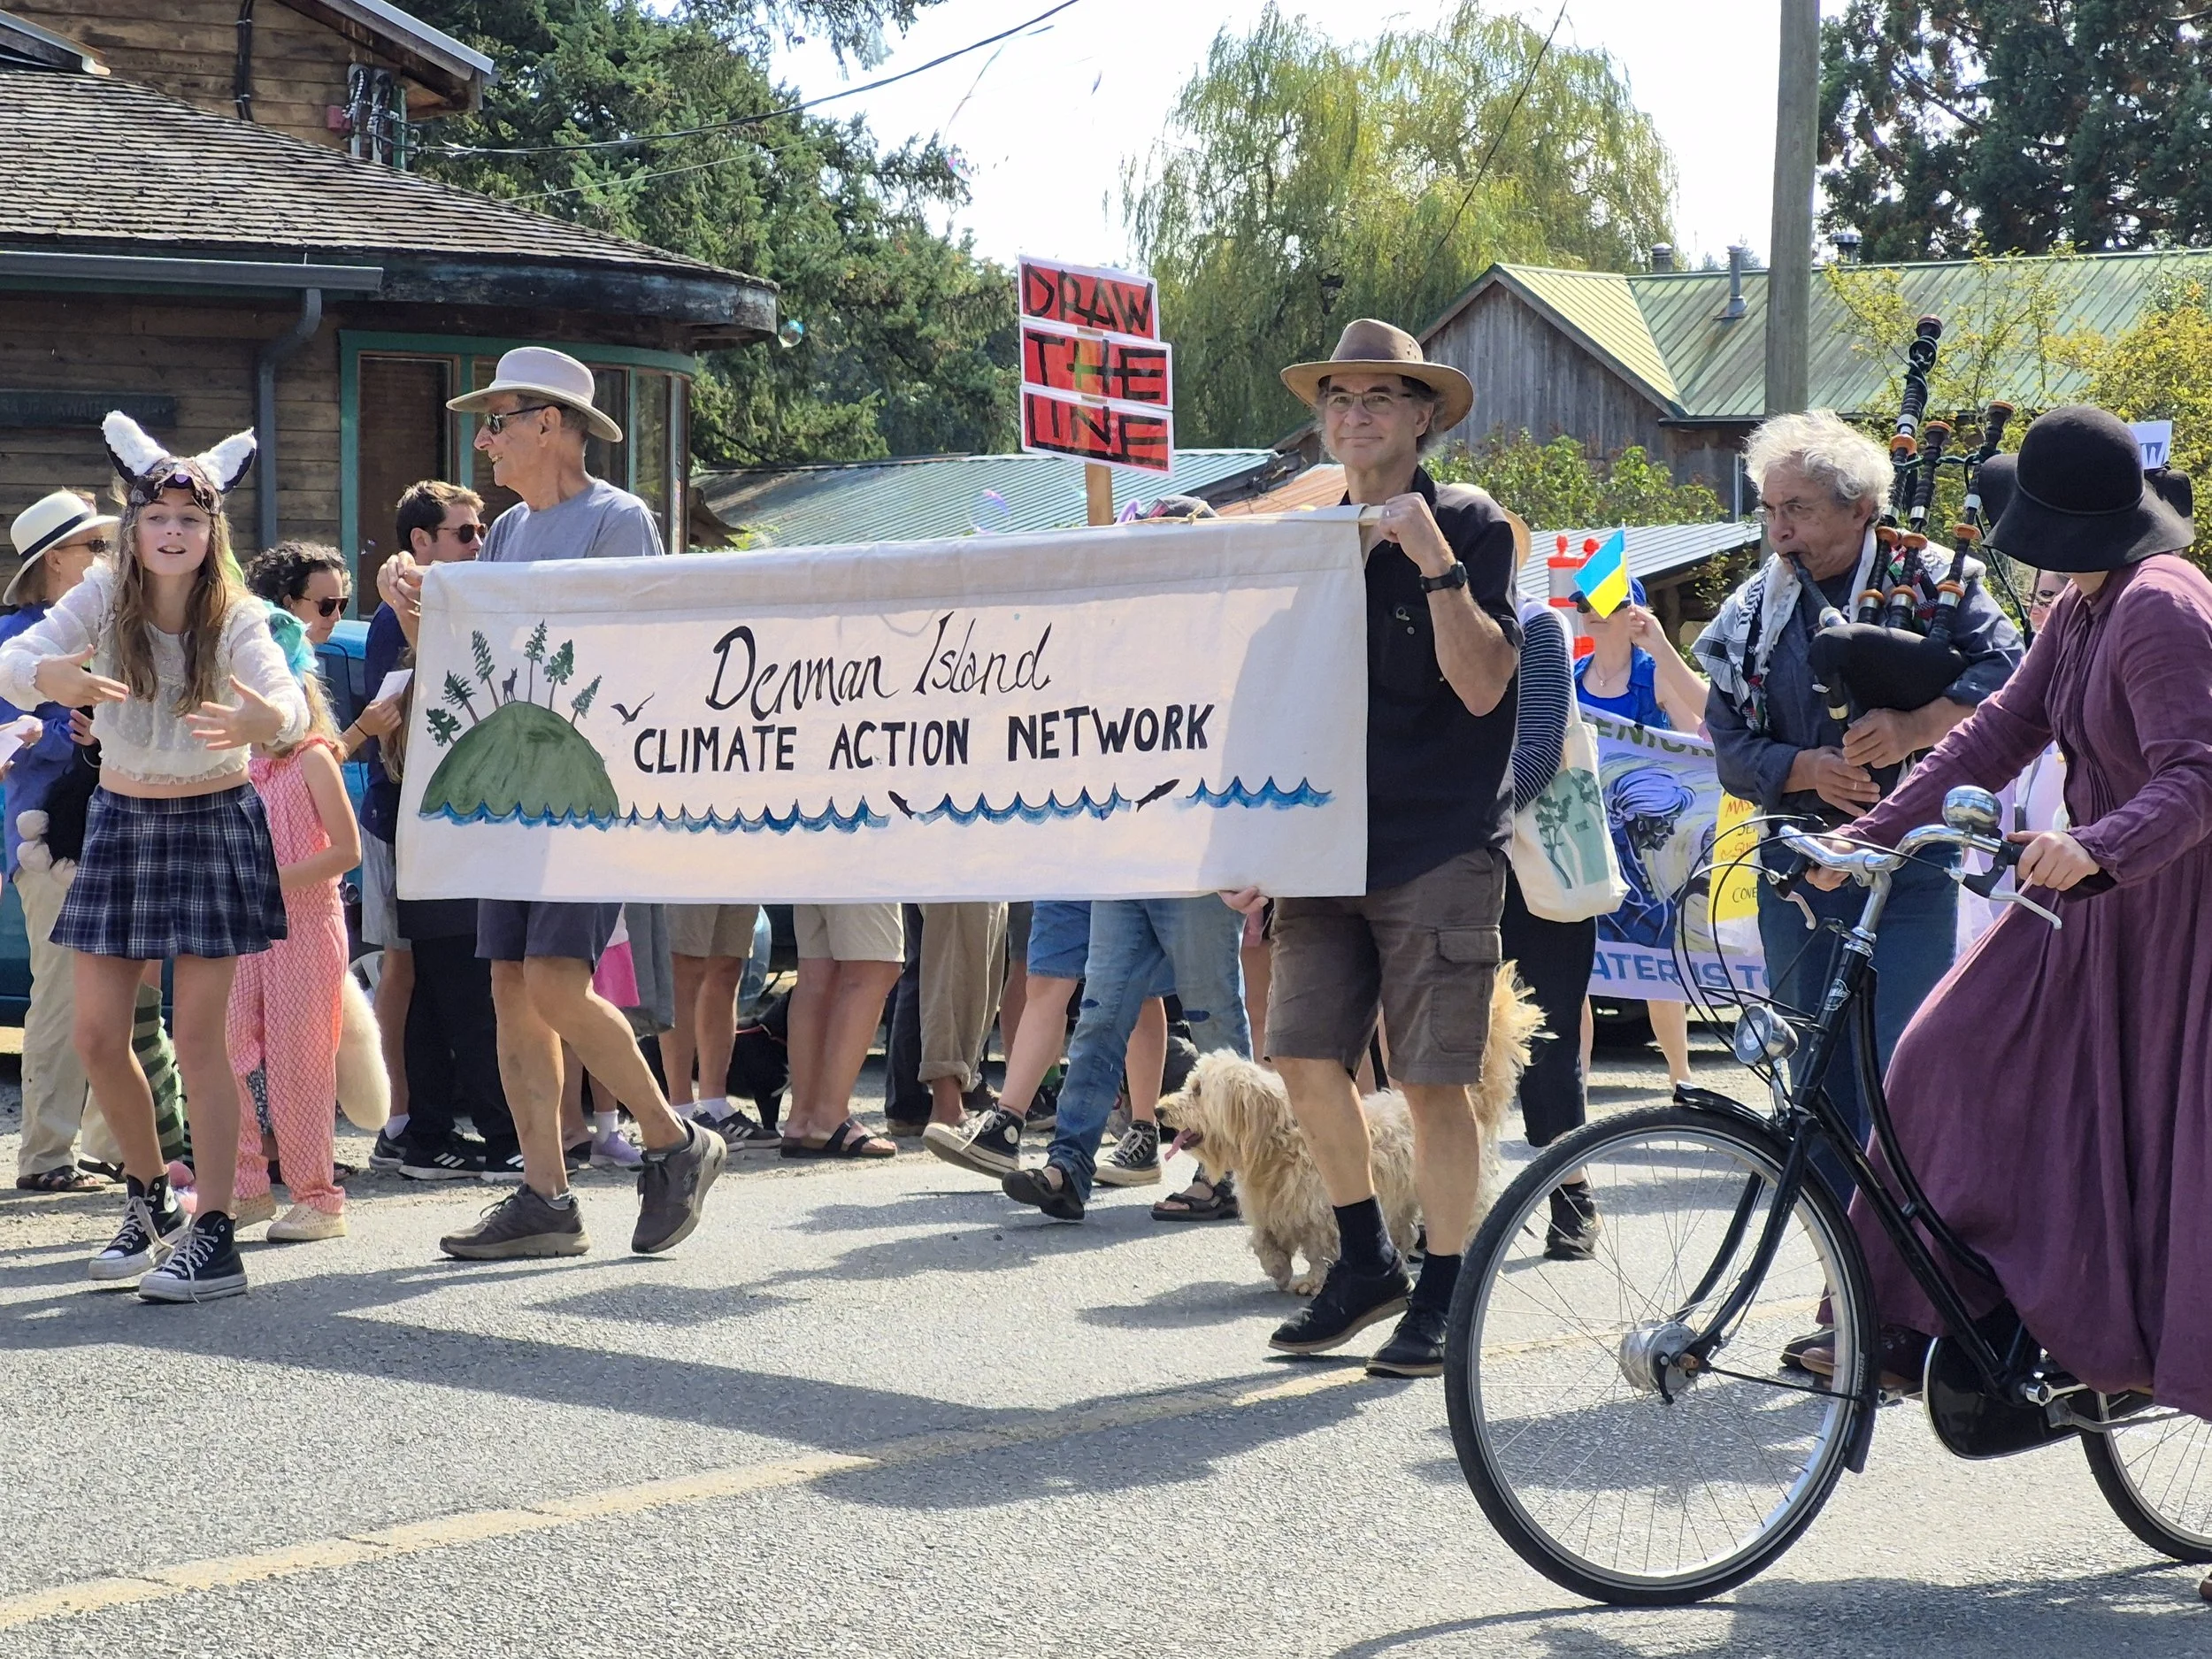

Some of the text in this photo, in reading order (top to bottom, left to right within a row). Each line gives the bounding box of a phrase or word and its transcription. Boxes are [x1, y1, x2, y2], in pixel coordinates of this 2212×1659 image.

[1025, 262, 1154, 334] DRAW
[1026, 332, 1167, 400] THE
[1027, 394, 1168, 467] LINE
[706, 611, 1052, 721] Denman Island
[634, 703, 1215, 774] CLIMATE ACTION NETWORK
[1692, 961, 1728, 987] IS
[1735, 964, 1770, 990] T
